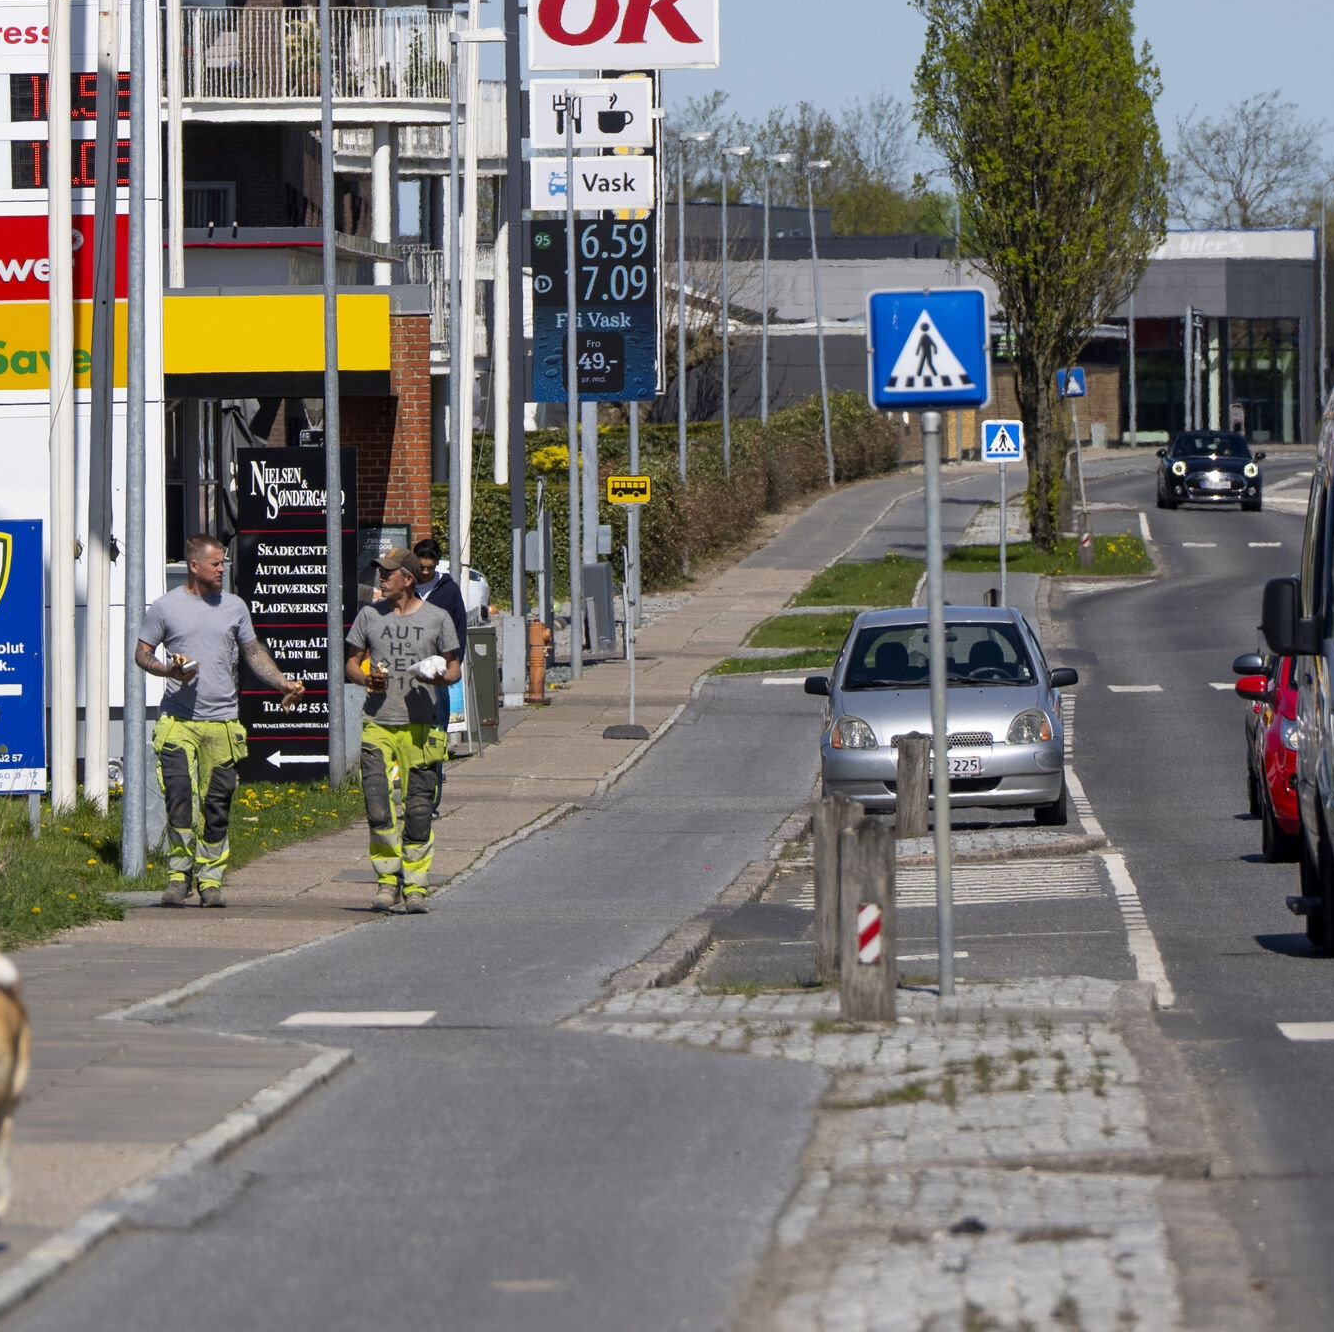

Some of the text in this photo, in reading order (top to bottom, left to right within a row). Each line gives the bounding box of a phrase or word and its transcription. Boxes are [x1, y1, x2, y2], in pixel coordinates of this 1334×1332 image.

[582, 172, 635, 192] Vask
[534, 223, 647, 259] 95 6.59
[564, 265, 647, 301] 7.09
[555, 311, 631, 328] Fi Vask
[587, 339, 601, 348] Fra
[301, 479, 308, 489] &
[380, 625, 424, 640] AUT
[288, 651, 304, 659] DIN
[305, 651, 320, 659] BIL
[297, 703, 307, 713] 42
[309, 703, 320, 714] 55
[12, 754, 23, 762] 57
[953, 759, 978, 772] 225
